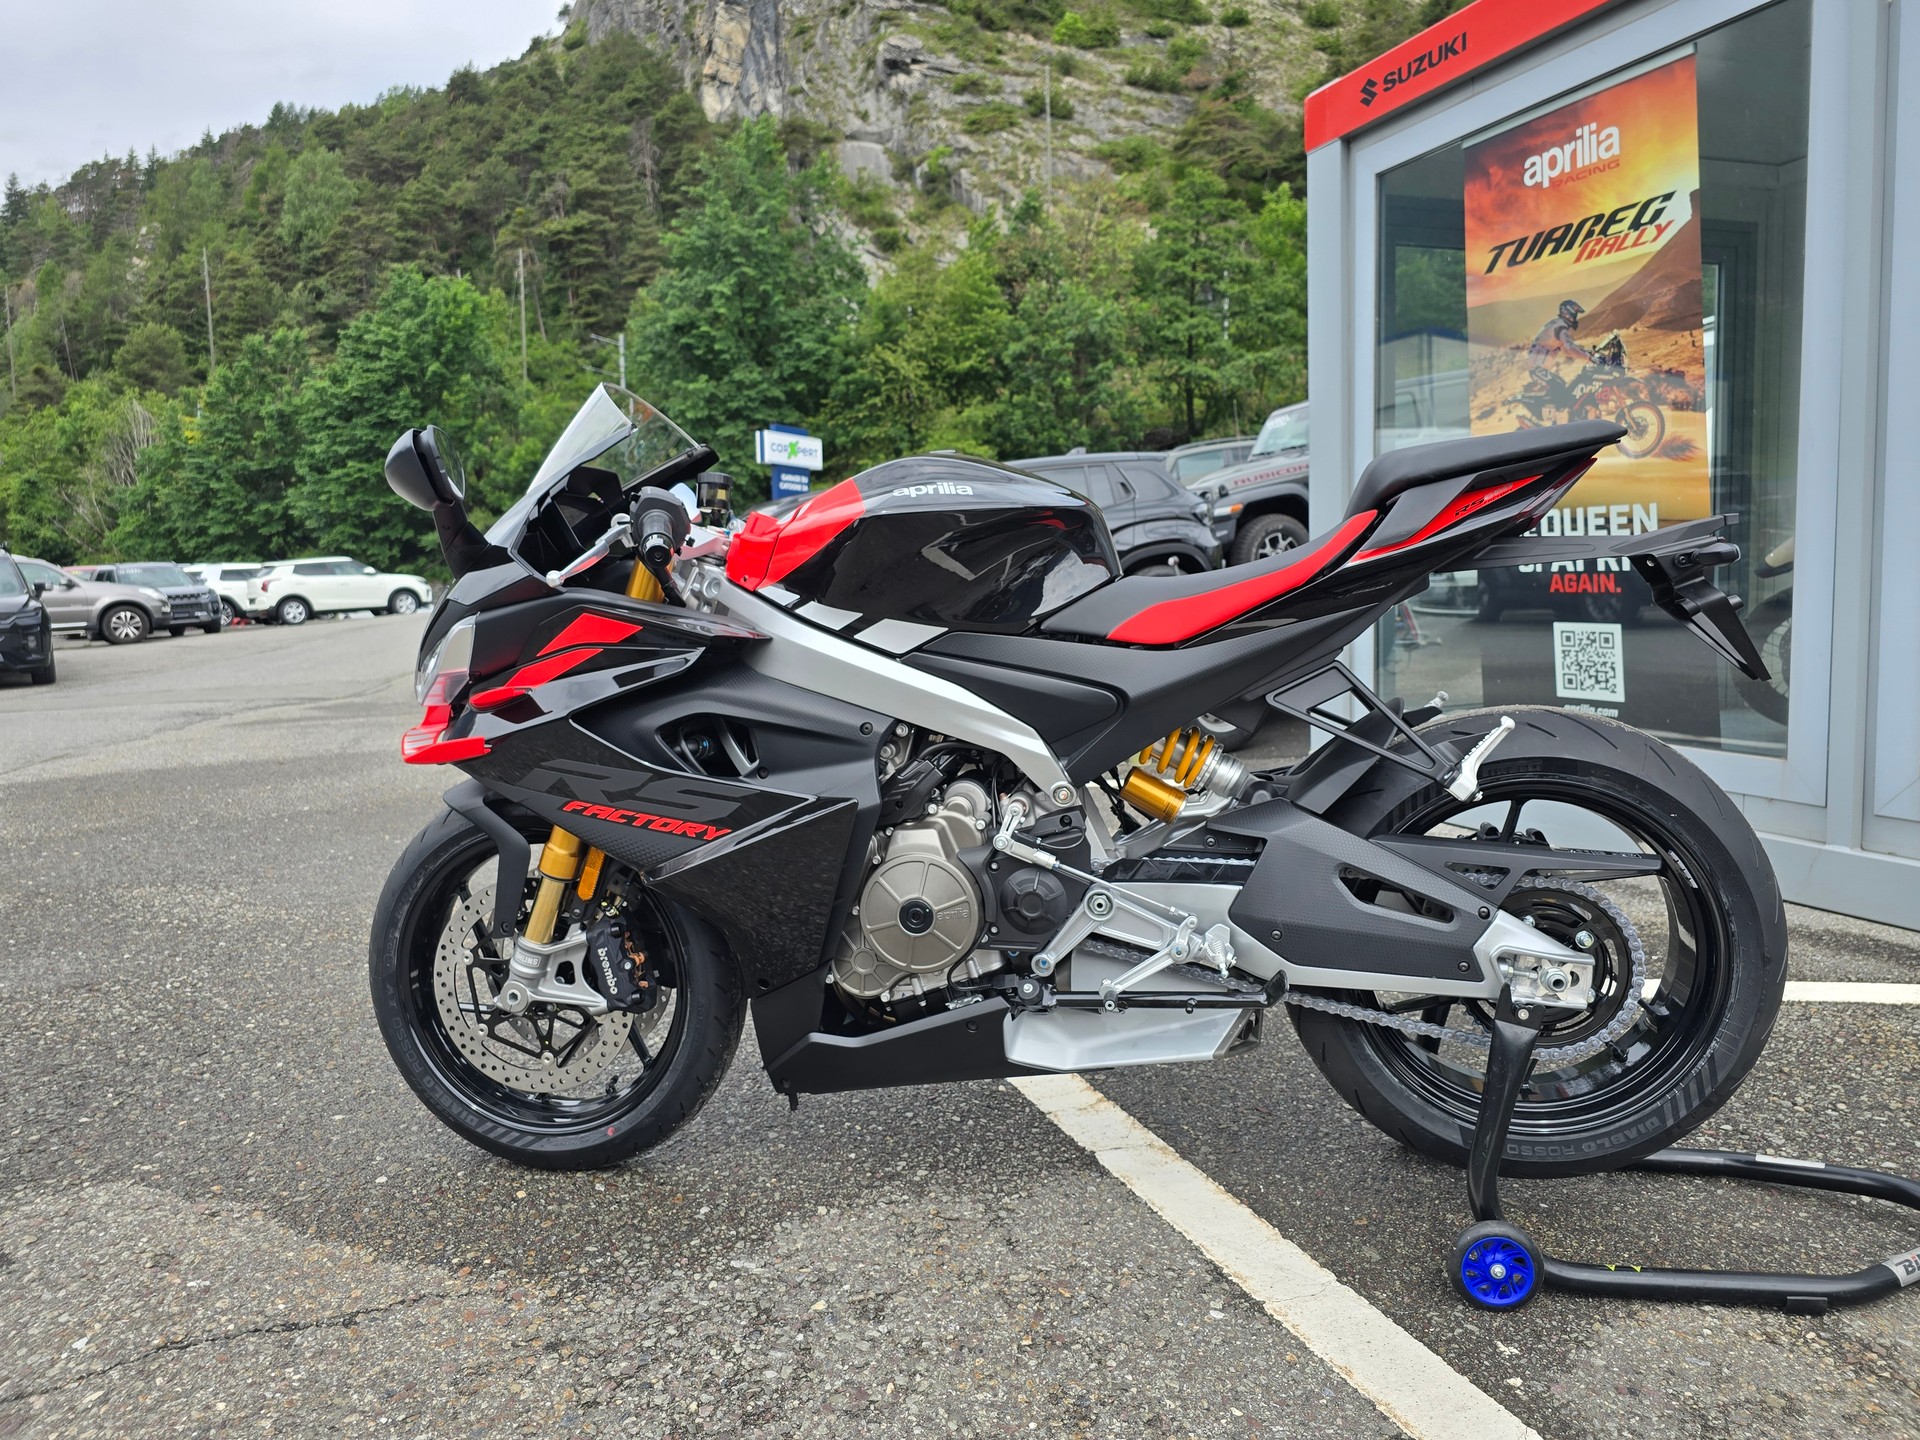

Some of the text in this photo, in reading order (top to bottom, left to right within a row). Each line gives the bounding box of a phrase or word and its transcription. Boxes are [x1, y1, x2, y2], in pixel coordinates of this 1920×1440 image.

[1382, 31, 1467, 93] SUZUKI
[1523, 122, 1621, 188] aprilia
[1483, 190, 1677, 276] TUAREG
[1573, 219, 1675, 264] RALLY
[892, 482, 974, 498] aprilia
[1540, 502, 1659, 537] QUEEN
[1550, 573, 1622, 593] AGAIN.
[516, 758, 761, 823] RS
[562, 800, 733, 841] FACTORY
[597, 947, 618, 995] brembo
[1506, 1115, 1663, 1157] DIABLO ROSSO
